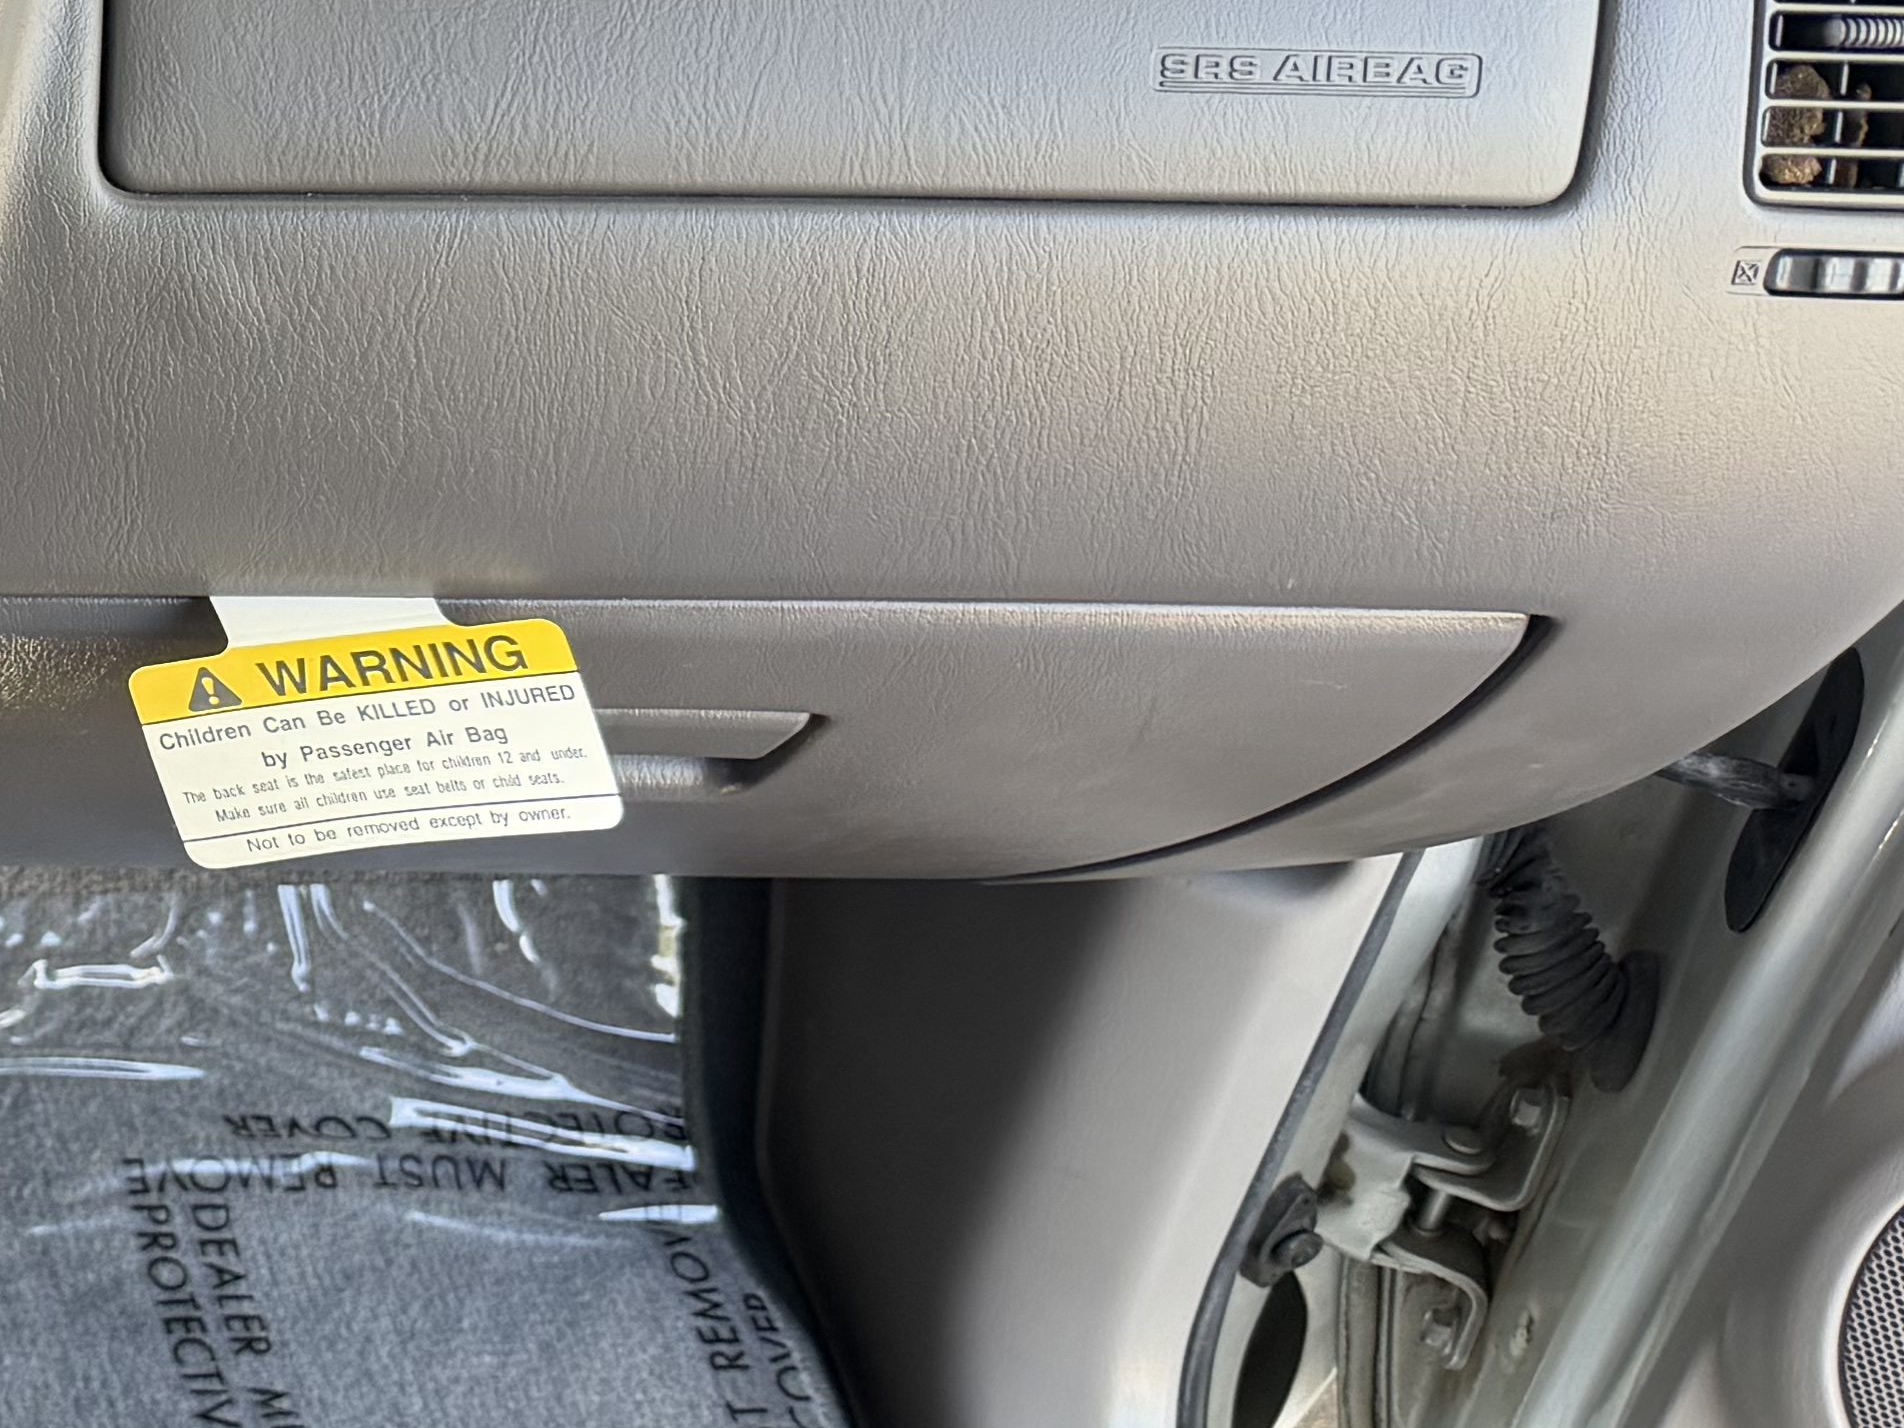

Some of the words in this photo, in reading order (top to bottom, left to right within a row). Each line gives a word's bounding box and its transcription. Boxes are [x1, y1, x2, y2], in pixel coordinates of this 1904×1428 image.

[1159, 52, 1259, 81] SRS
[1272, 54, 1471, 86] AIRBAG
[255, 635, 529, 697] WARNING
[158, 723, 252, 751] Children
[262, 713, 306, 735] Can
[316, 709, 347, 727] Be
[356, 698, 437, 722] KILLED
[448, 697, 470, 712] or
[480, 684, 576, 709] INJURED
[261, 750, 288, 770] by
[299, 735, 413, 763] Passenger
[426, 729, 454, 748] Air
[465, 726, 509, 745] Bag
[182, 789, 207, 805] The
[212, 783, 246, 800] back
[251, 778, 281, 795] seat
[284, 774, 300, 789] is
[304, 771, 326, 786] the
[332, 766, 372, 782] safest
[377, 761, 412, 780] place
[416, 758, 436, 773] for
[441, 753, 493, 771] children
[496, 750, 515, 765] 12
[518, 748, 542, 763] and
[550, 746, 589, 761] under.
[214, 805, 252, 823] Make
[257, 802, 288, 817] sure
[315, 790, 369, 808] children
[373, 786, 397, 801] use
[403, 782, 432, 798] seat
[435, 778, 468, 794] belts
[472, 777, 487, 791] or
[492, 773, 523, 789] child
[528, 771, 566, 786] seats.
[246, 836, 280, 853] Not
[287, 832, 307, 847] to
[313, 827, 338, 842] be
[346, 816, 421, 839] removed
[429, 811, 484, 830] except
[489, 810, 510, 828] by
[518, 806, 573, 823] owner.
[223, 1113, 391, 1142] COVER
[374, 1152, 506, 1192] MUST
[190, 1203, 272, 1358] DEALER
